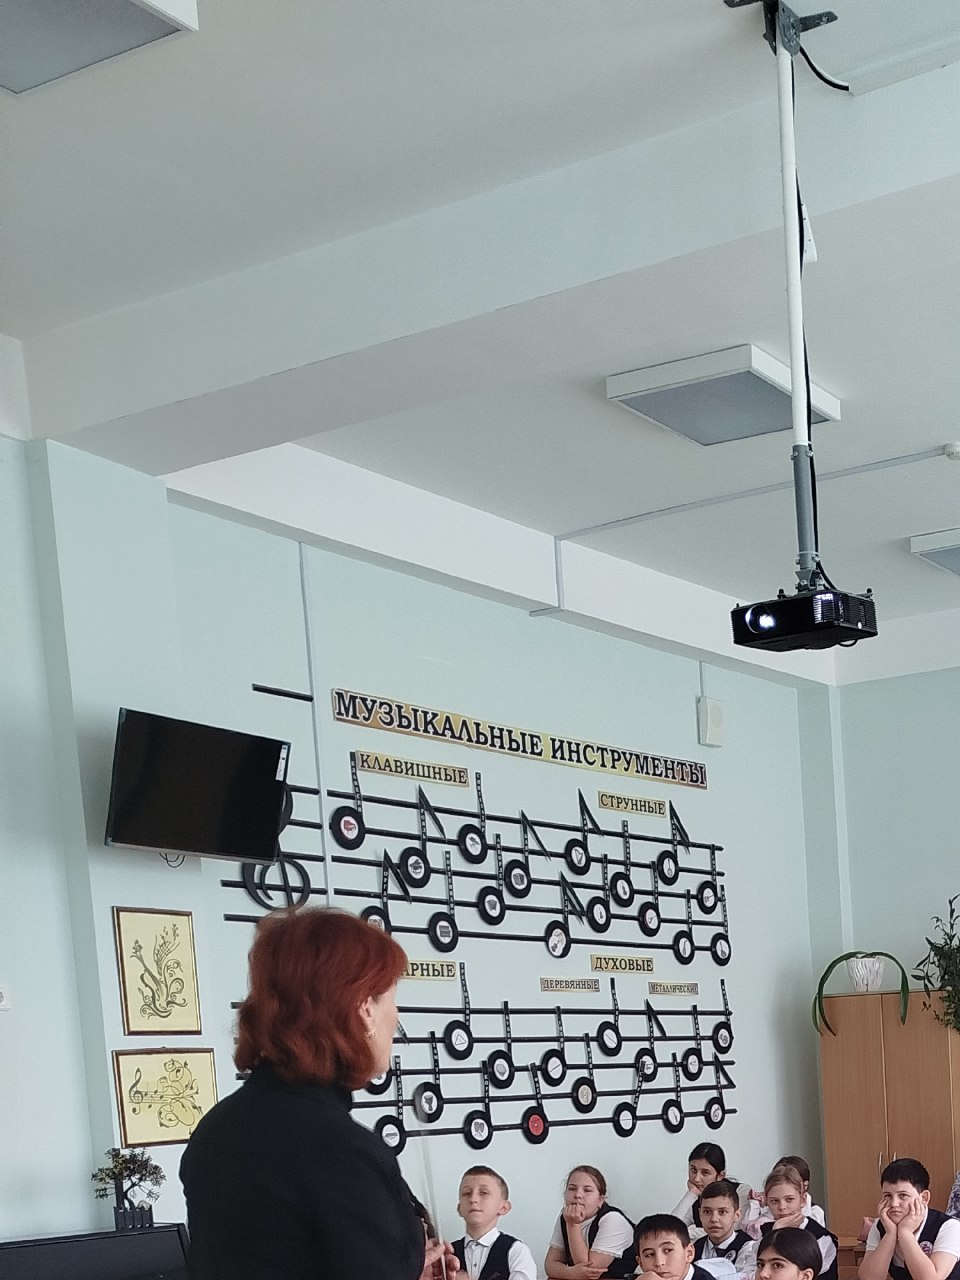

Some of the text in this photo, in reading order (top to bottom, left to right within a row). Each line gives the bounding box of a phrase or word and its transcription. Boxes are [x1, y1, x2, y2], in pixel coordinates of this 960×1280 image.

[334, 690, 707, 785] МУЗЫКАЛЬНЫЕ ИНСТРУМЕНТЫ
[359, 753, 468, 785] КЛАВИШНЫЕ
[600, 793, 666, 816] СТРУННЫЕ
[401, 962, 456, 978] АРНЫЕ
[594, 956, 654, 972] ДУХОВЫЕ
[543, 979, 599, 990] ДЕРЕВЯННЫЕ
